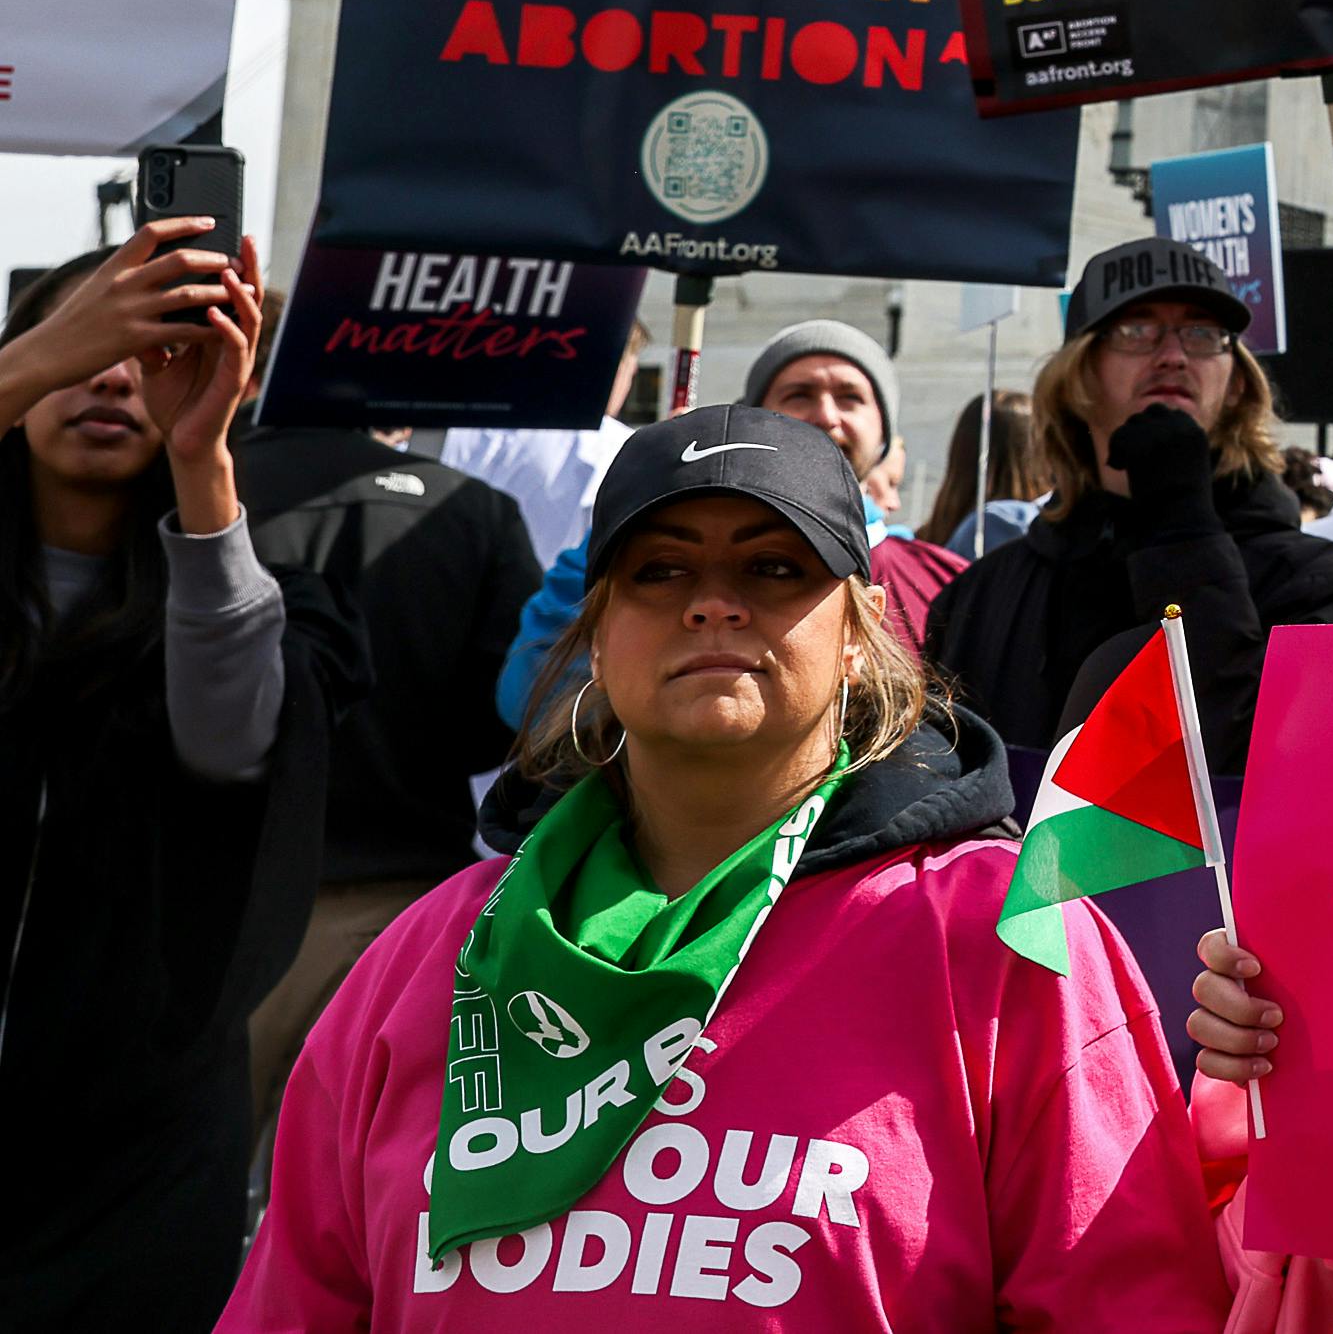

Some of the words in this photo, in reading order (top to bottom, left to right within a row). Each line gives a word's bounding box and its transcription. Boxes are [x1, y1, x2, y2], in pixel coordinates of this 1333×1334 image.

[439, 0, 926, 92] ABORTION
[1025, 58, 1134, 86] aafront.org
[620, 232, 778, 267] AAFront.org
[1168, 193, 1256, 242] WOMEN'S
[370, 252, 574, 318] HEALTH
[325, 302, 588, 360] matters
[447, 1060, 637, 1171] OUR
[623, 1122, 869, 1228] OUR
[413, 1210, 811, 1308] BODIES
